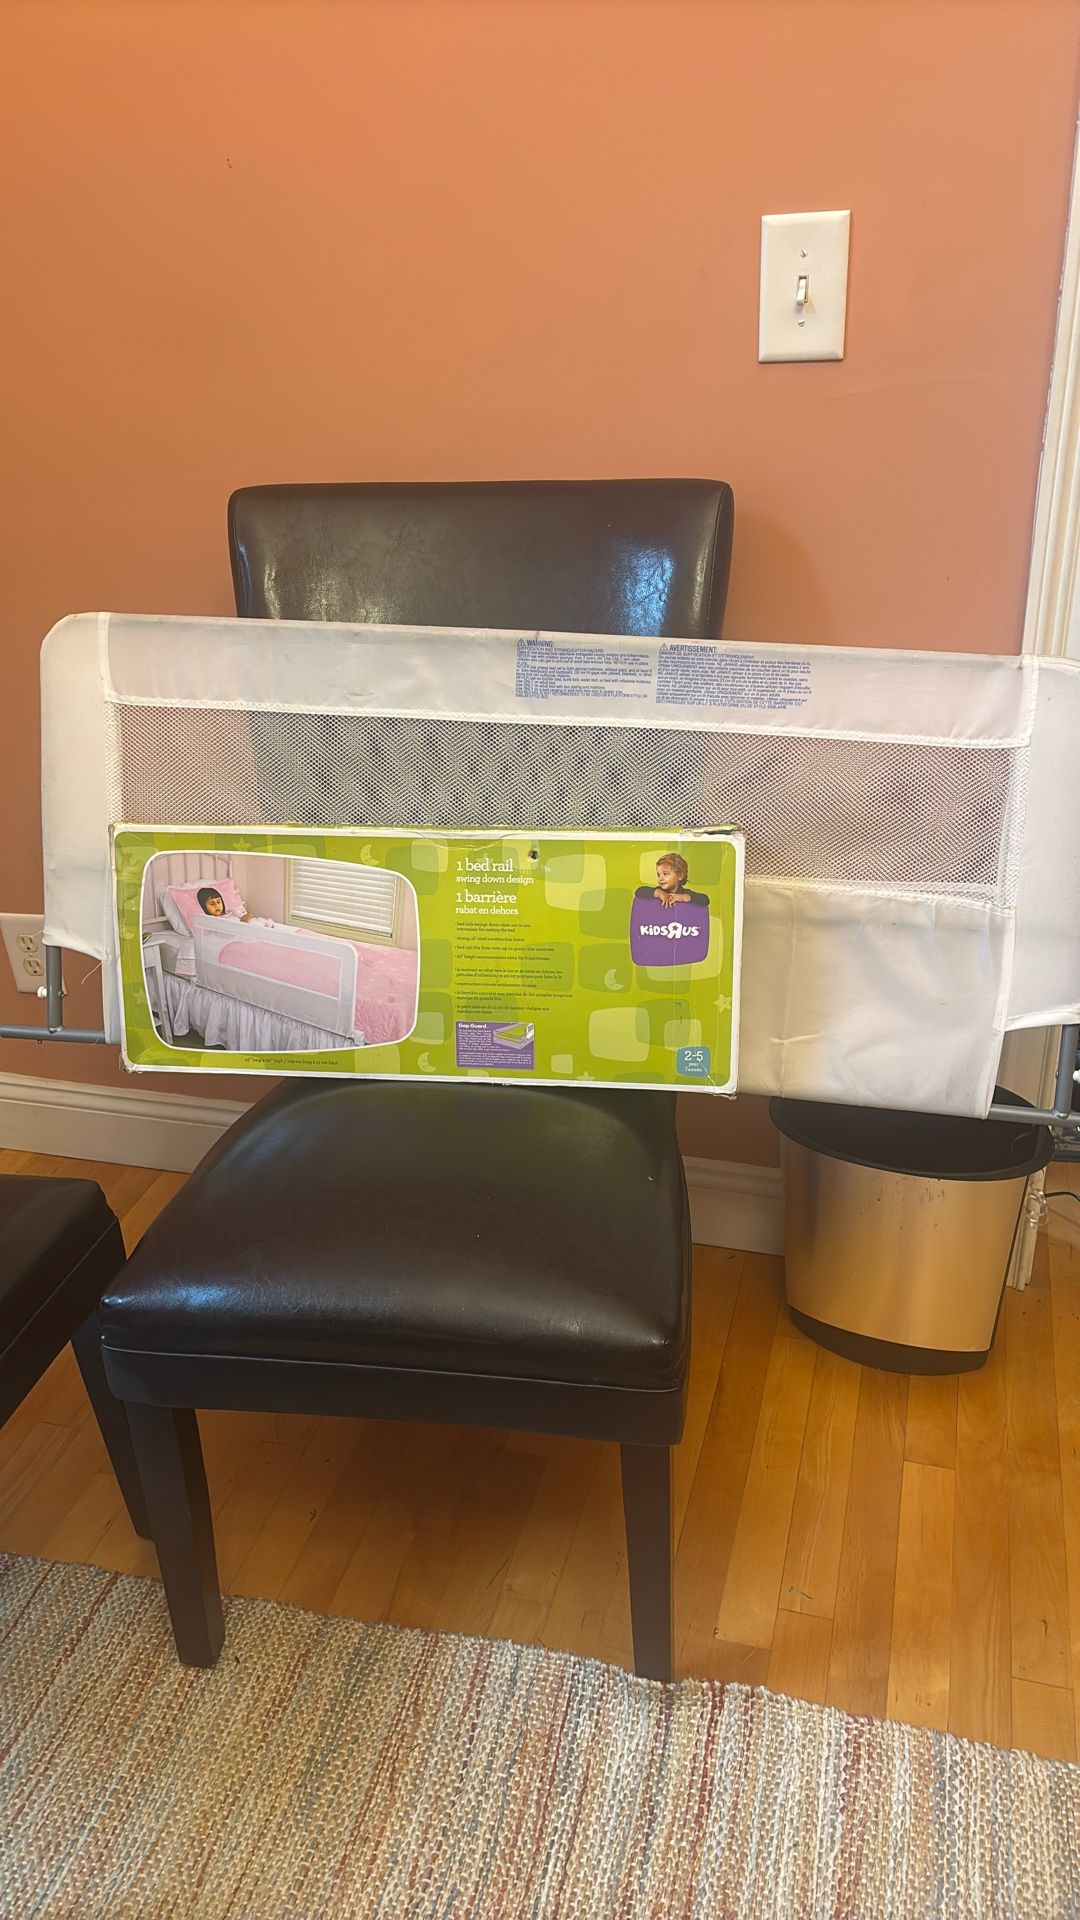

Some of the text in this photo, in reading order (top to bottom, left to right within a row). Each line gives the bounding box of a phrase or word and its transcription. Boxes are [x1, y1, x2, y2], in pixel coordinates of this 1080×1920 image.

[669, 644, 718, 653] AVERTISSEMENT:
[456, 857, 514, 872] 1 bed rail
[456, 874, 534, 885] swing down design
[456, 889, 517, 903] 1 barrière
[456, 905, 477, 914] rabat
[490, 906, 518, 915] dehors
[684, 1050, 703, 1061] 2-5
